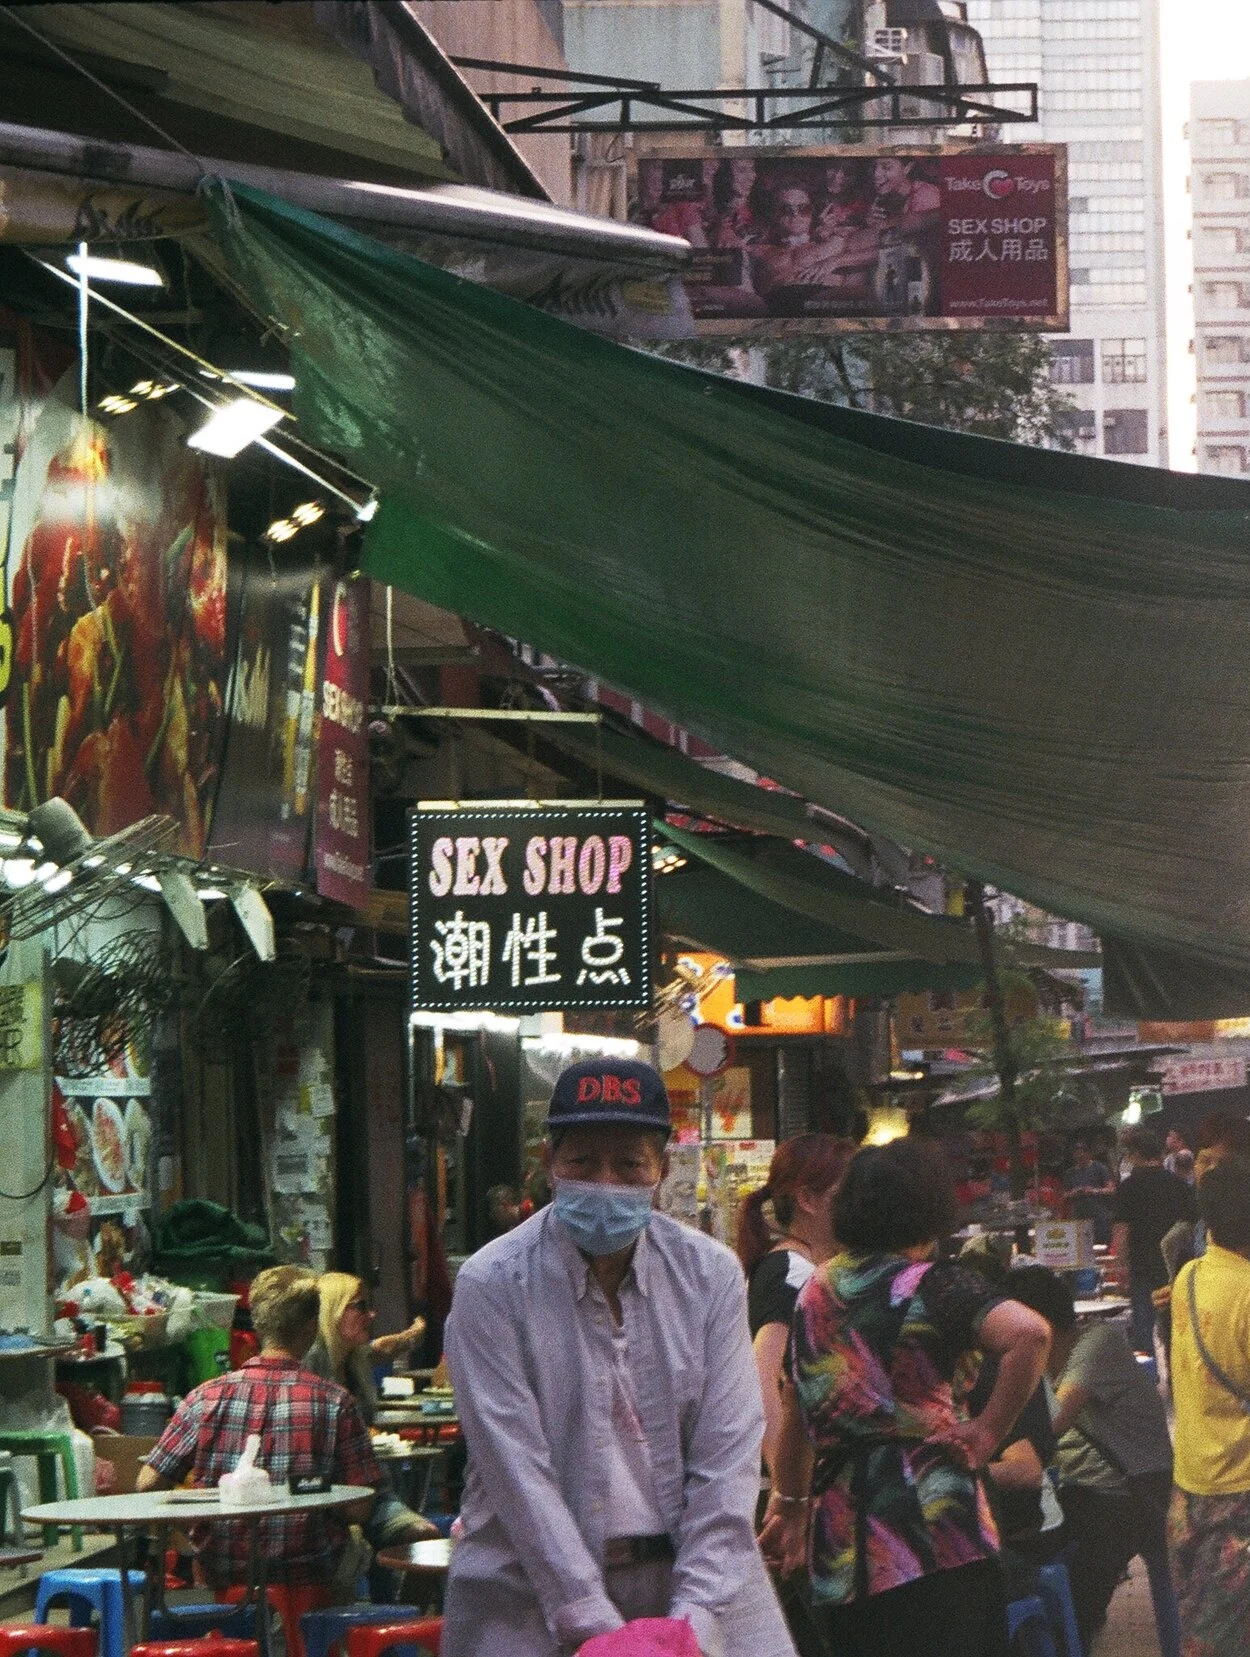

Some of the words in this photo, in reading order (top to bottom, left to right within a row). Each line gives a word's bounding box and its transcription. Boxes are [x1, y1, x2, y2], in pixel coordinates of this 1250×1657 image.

[944, 177, 981, 191] Take
[1013, 177, 1050, 193] Toys
[947, 217, 987, 235] SEX
[990, 217, 1046, 234] SHOP
[948, 238, 1049, 262] 成人用品
[429, 836, 509, 897] SEX
[523, 834, 633, 896] SHOP
[430, 906, 632, 991] 潮性点
[576, 1073, 642, 1106] DBS
